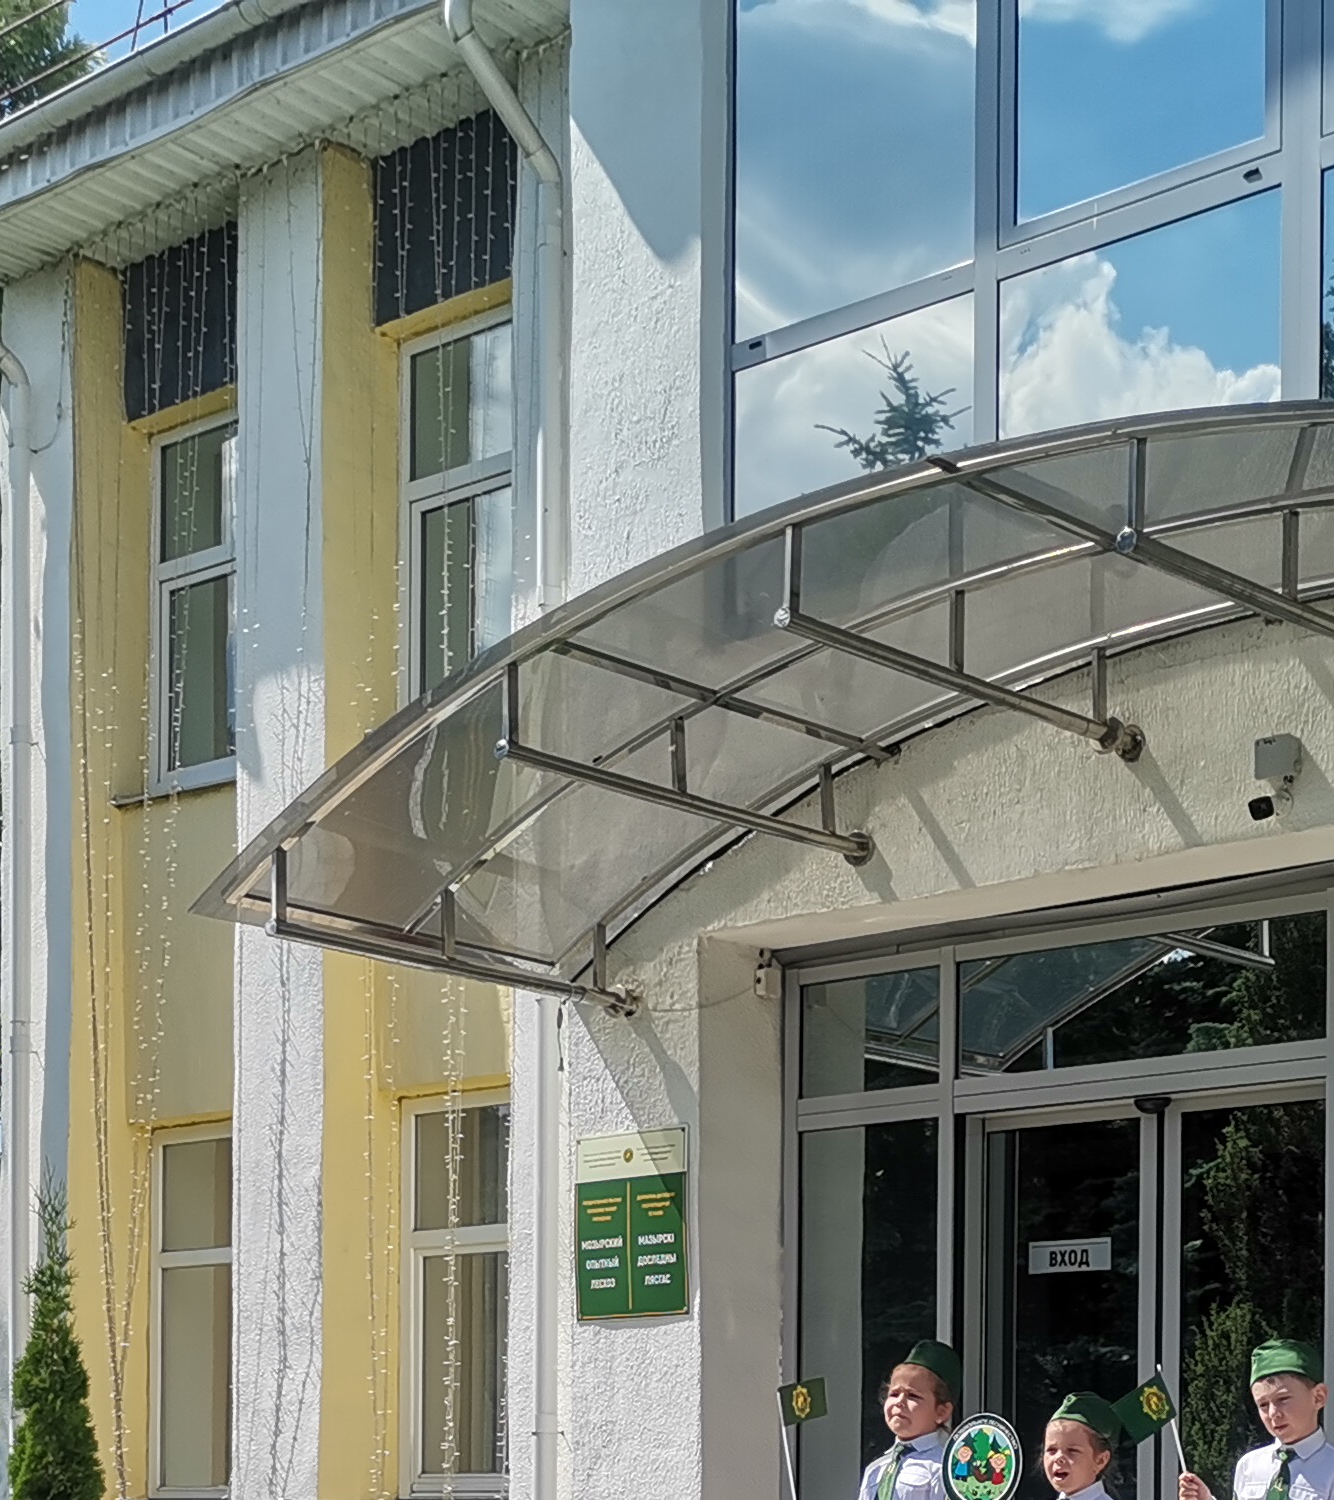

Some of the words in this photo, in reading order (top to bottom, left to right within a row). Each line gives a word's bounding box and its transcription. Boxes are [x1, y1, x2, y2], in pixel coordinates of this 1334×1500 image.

[581, 1235, 623, 1250] МОЗЫРСКИЙ
[586, 1255, 619, 1270] ОПЫТНЫЙ
[637, 1253, 677, 1267] ДОСЛЕДНЫ
[1049, 1249, 1090, 1268] ВХОД
[590, 1278, 615, 1289] ЛЕСХОЗ
